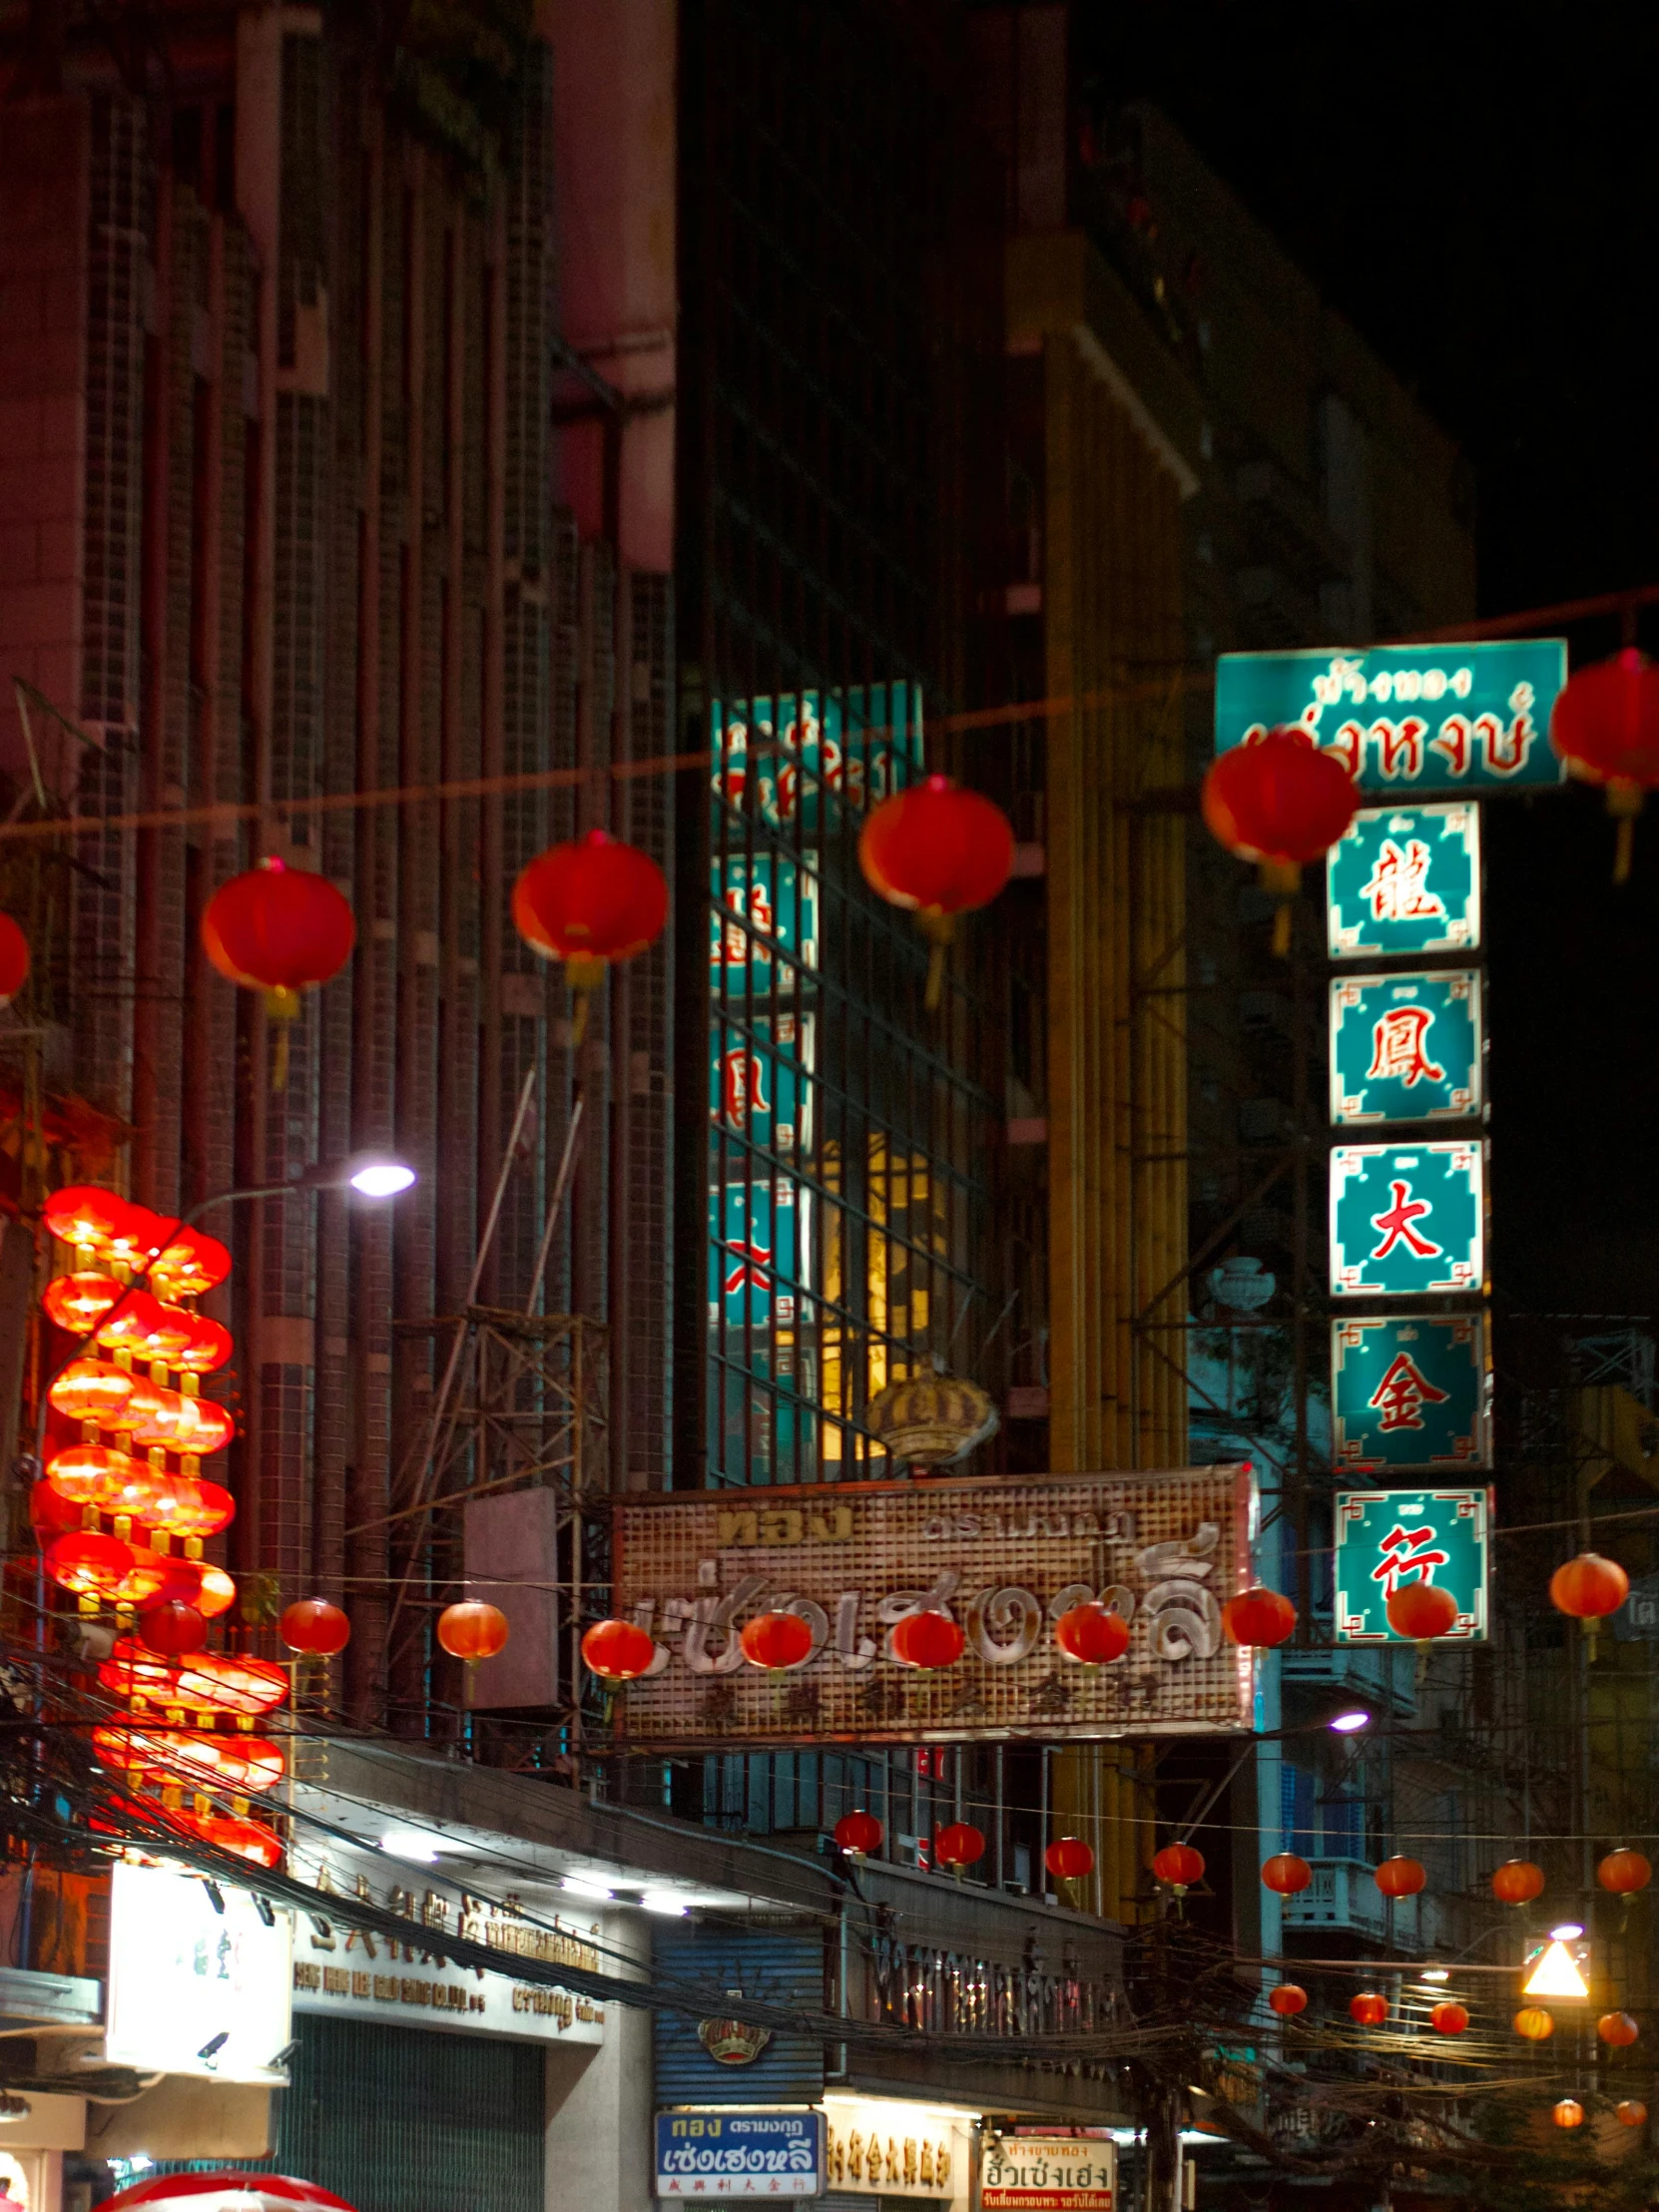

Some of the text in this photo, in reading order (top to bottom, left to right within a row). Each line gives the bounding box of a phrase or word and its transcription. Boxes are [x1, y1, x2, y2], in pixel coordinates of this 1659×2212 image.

[1312, 657, 1472, 704] ห้างทอง
[1243, 681, 1538, 778] ่งหงษ์
[717, 1505, 853, 1546] ทอง
[672, 2119, 803, 2137] ทอง ตรามงกุฎ
[663, 2138, 813, 2172] เซ่งเฮงหลี
